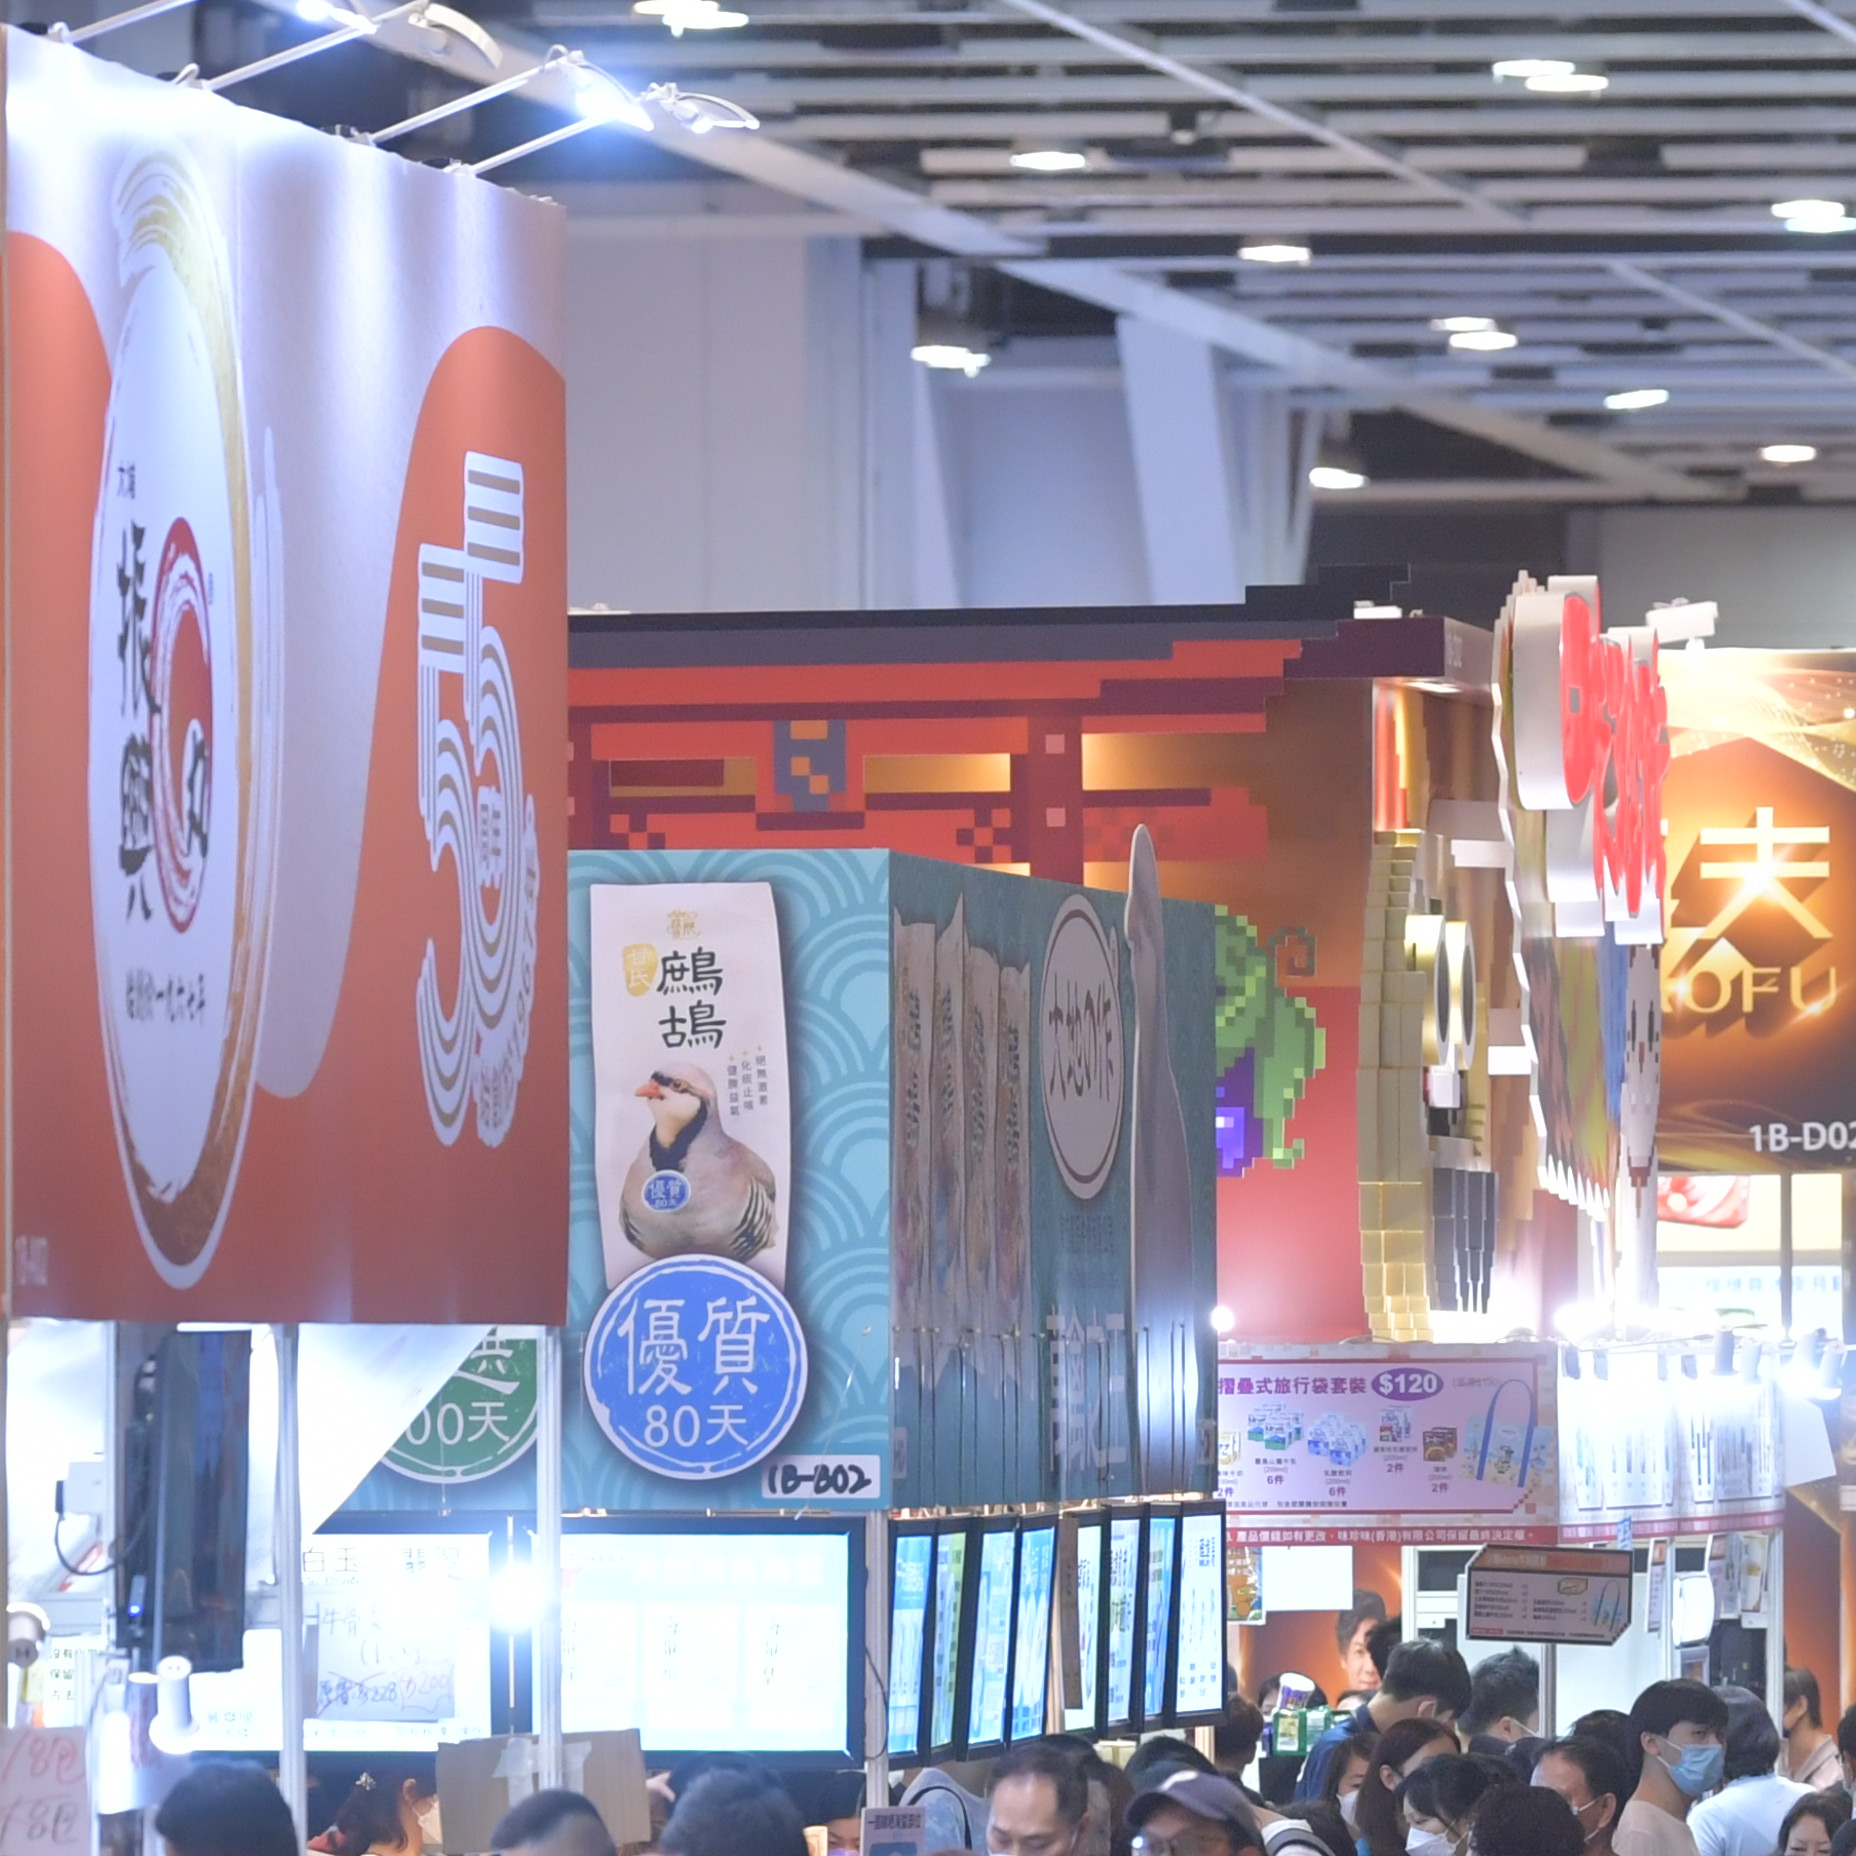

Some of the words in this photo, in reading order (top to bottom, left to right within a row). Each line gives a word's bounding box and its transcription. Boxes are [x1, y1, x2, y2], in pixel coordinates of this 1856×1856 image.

[656, 946, 727, 1049] 鷓鴣
[616, 1295, 772, 1397] 優質
[1378, 1372, 1438, 1396] $120
[644, 1407, 748, 1449] 80天
[768, 1463, 872, 1495] 1B-B02
